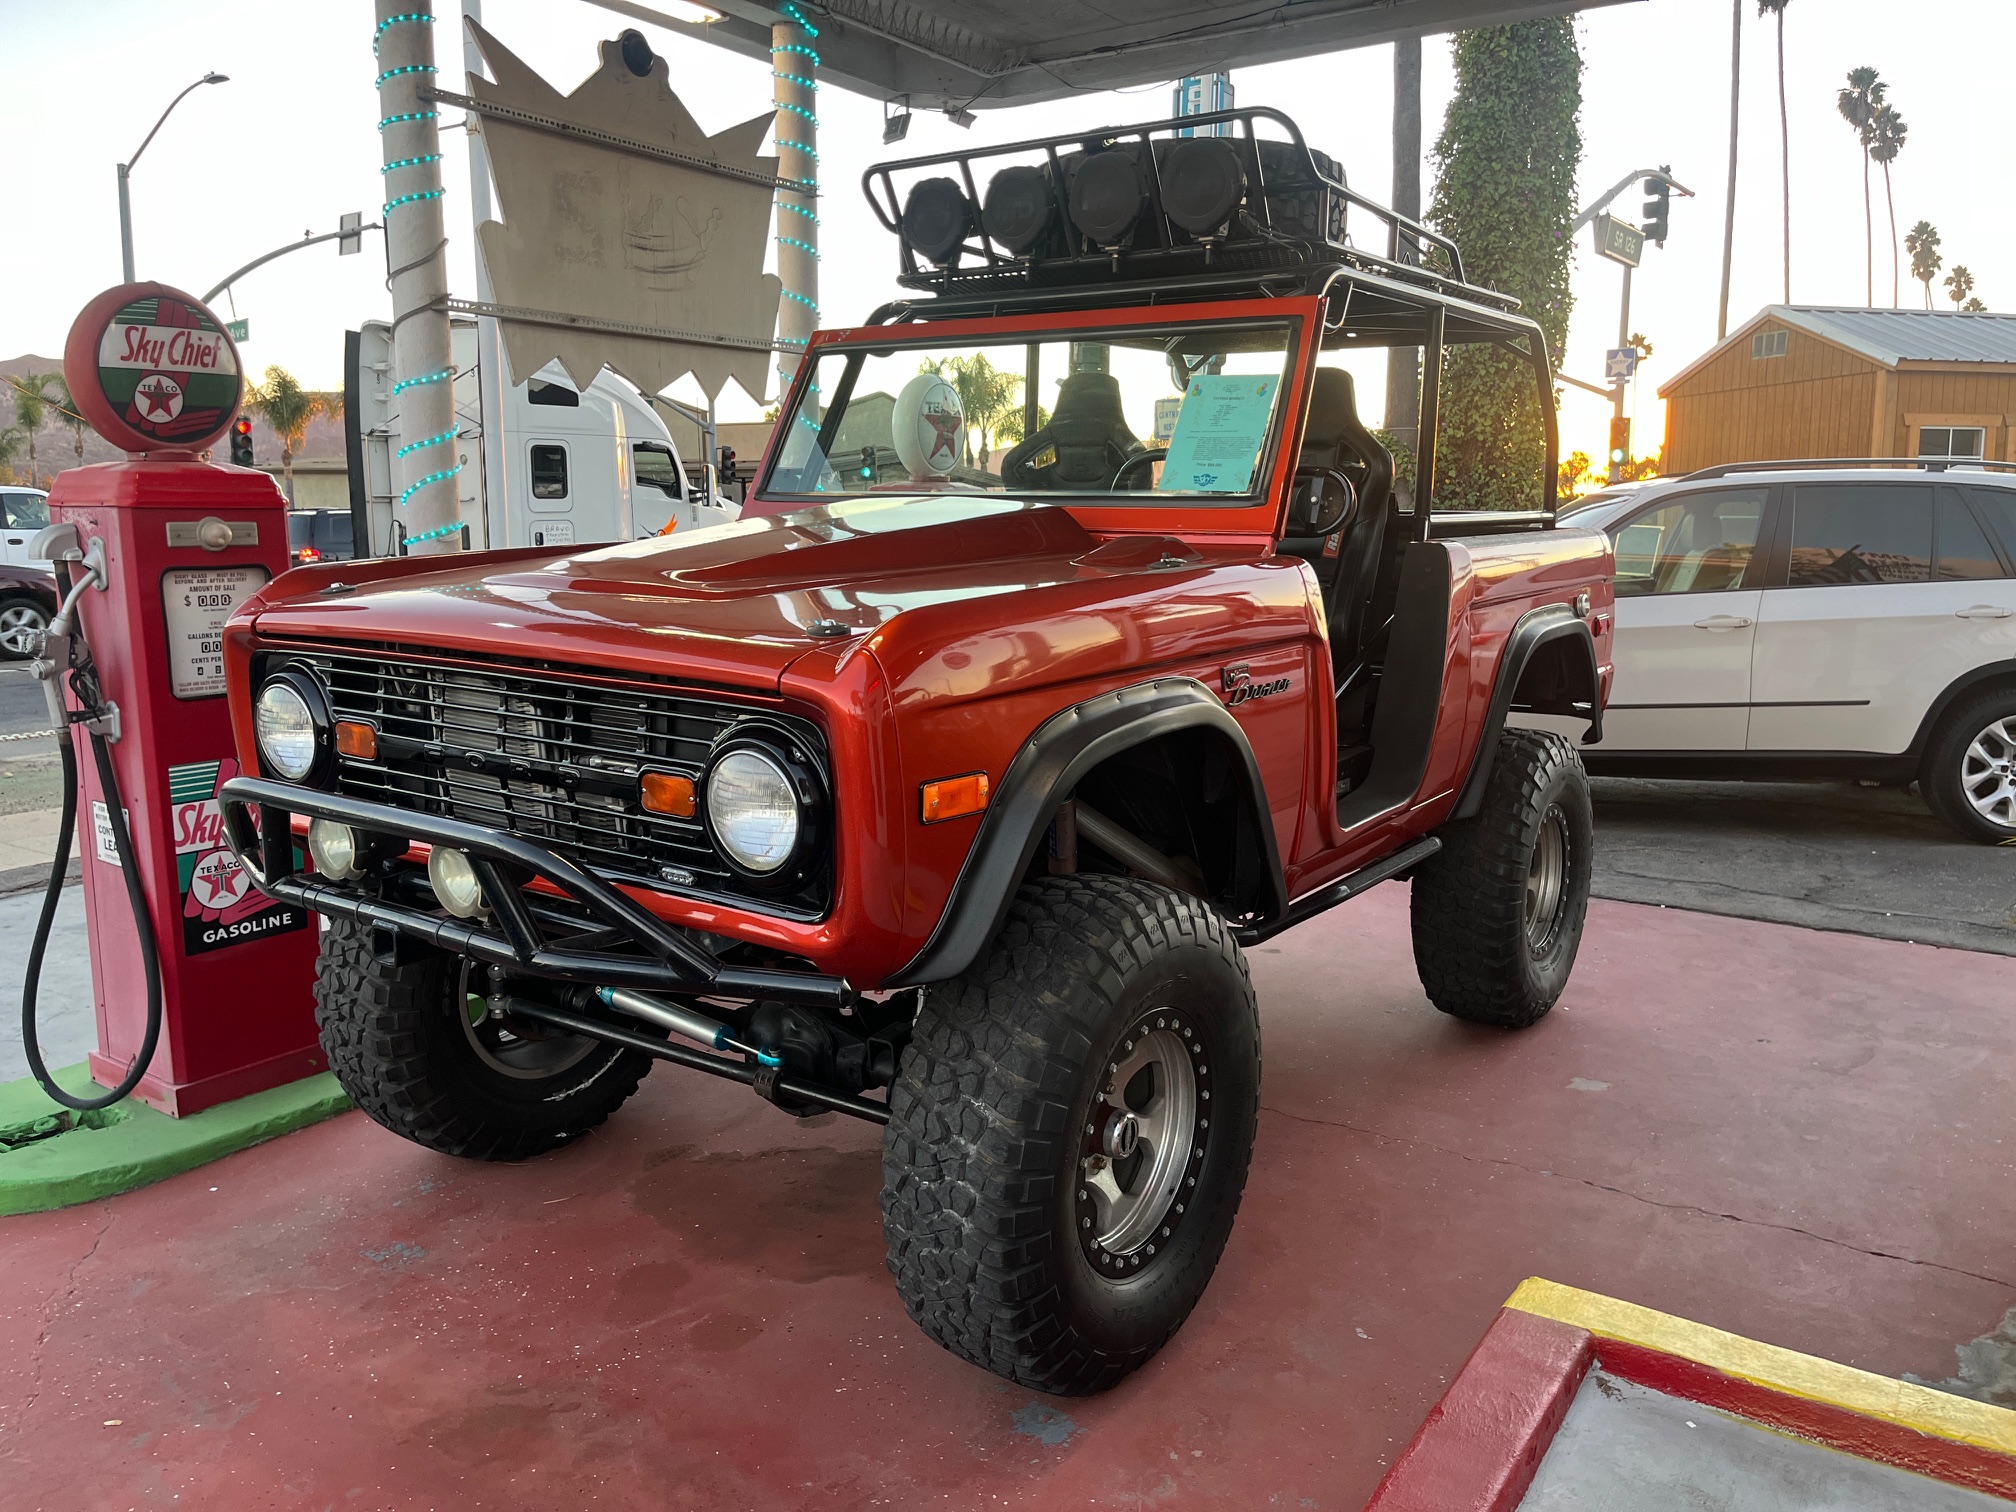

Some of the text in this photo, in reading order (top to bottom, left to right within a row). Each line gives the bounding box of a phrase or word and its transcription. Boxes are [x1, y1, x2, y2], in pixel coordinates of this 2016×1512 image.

[1614, 230, 1636, 255] SR 126
[231, 328, 247, 339] Ave
[120, 325, 222, 368] Sky Chief
[545, 524, 570, 532] BRAVO
[184, 594, 192, 607] $
[1229, 673, 1292, 706] Bronco
[175, 802, 224, 847] Sky
[200, 861, 241, 875] TEXACO
[203, 913, 292, 943] GASOLINE
